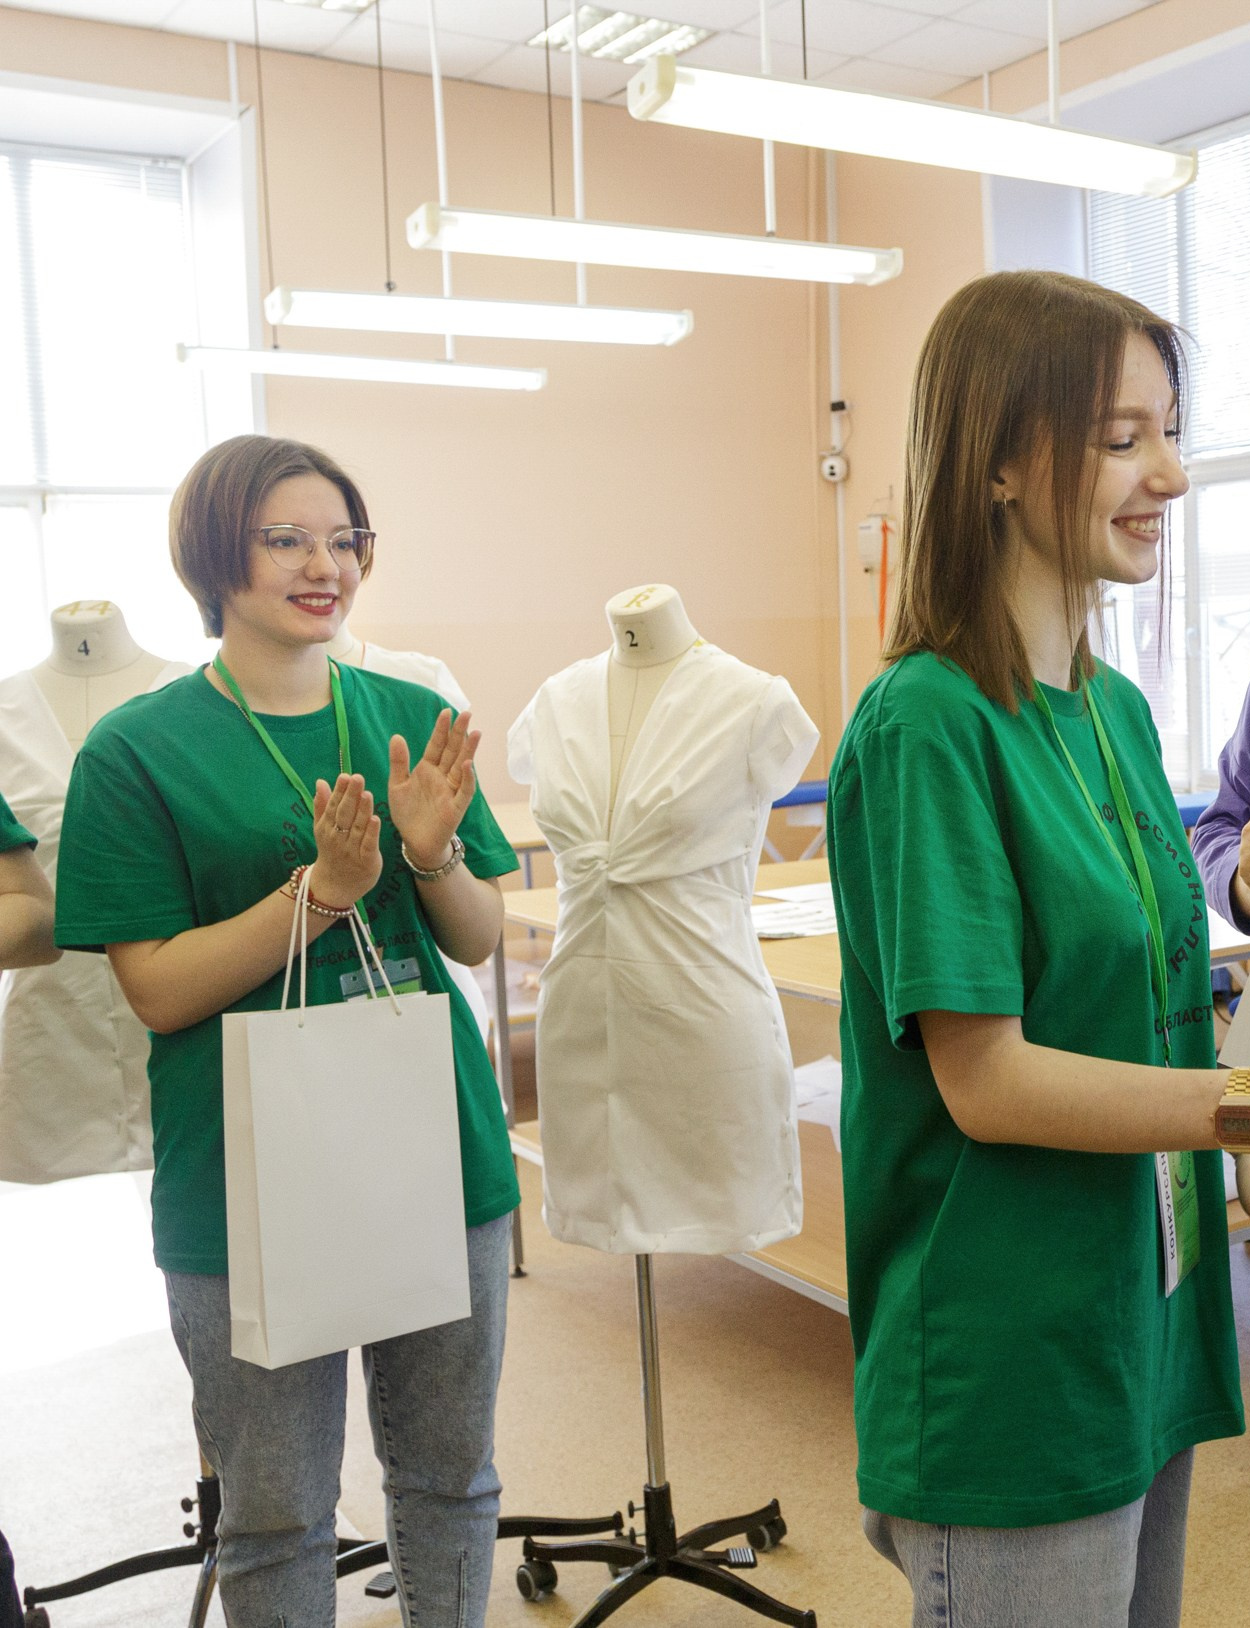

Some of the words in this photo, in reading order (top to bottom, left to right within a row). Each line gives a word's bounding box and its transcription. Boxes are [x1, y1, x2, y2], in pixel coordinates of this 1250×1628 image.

[77, 639, 90, 656] 4
[625, 630, 639, 647] 2
[1155, 1004, 1212, 1034] ОБЛАСТ
[1160, 1153, 1176, 1260] КОНКУРСАН
